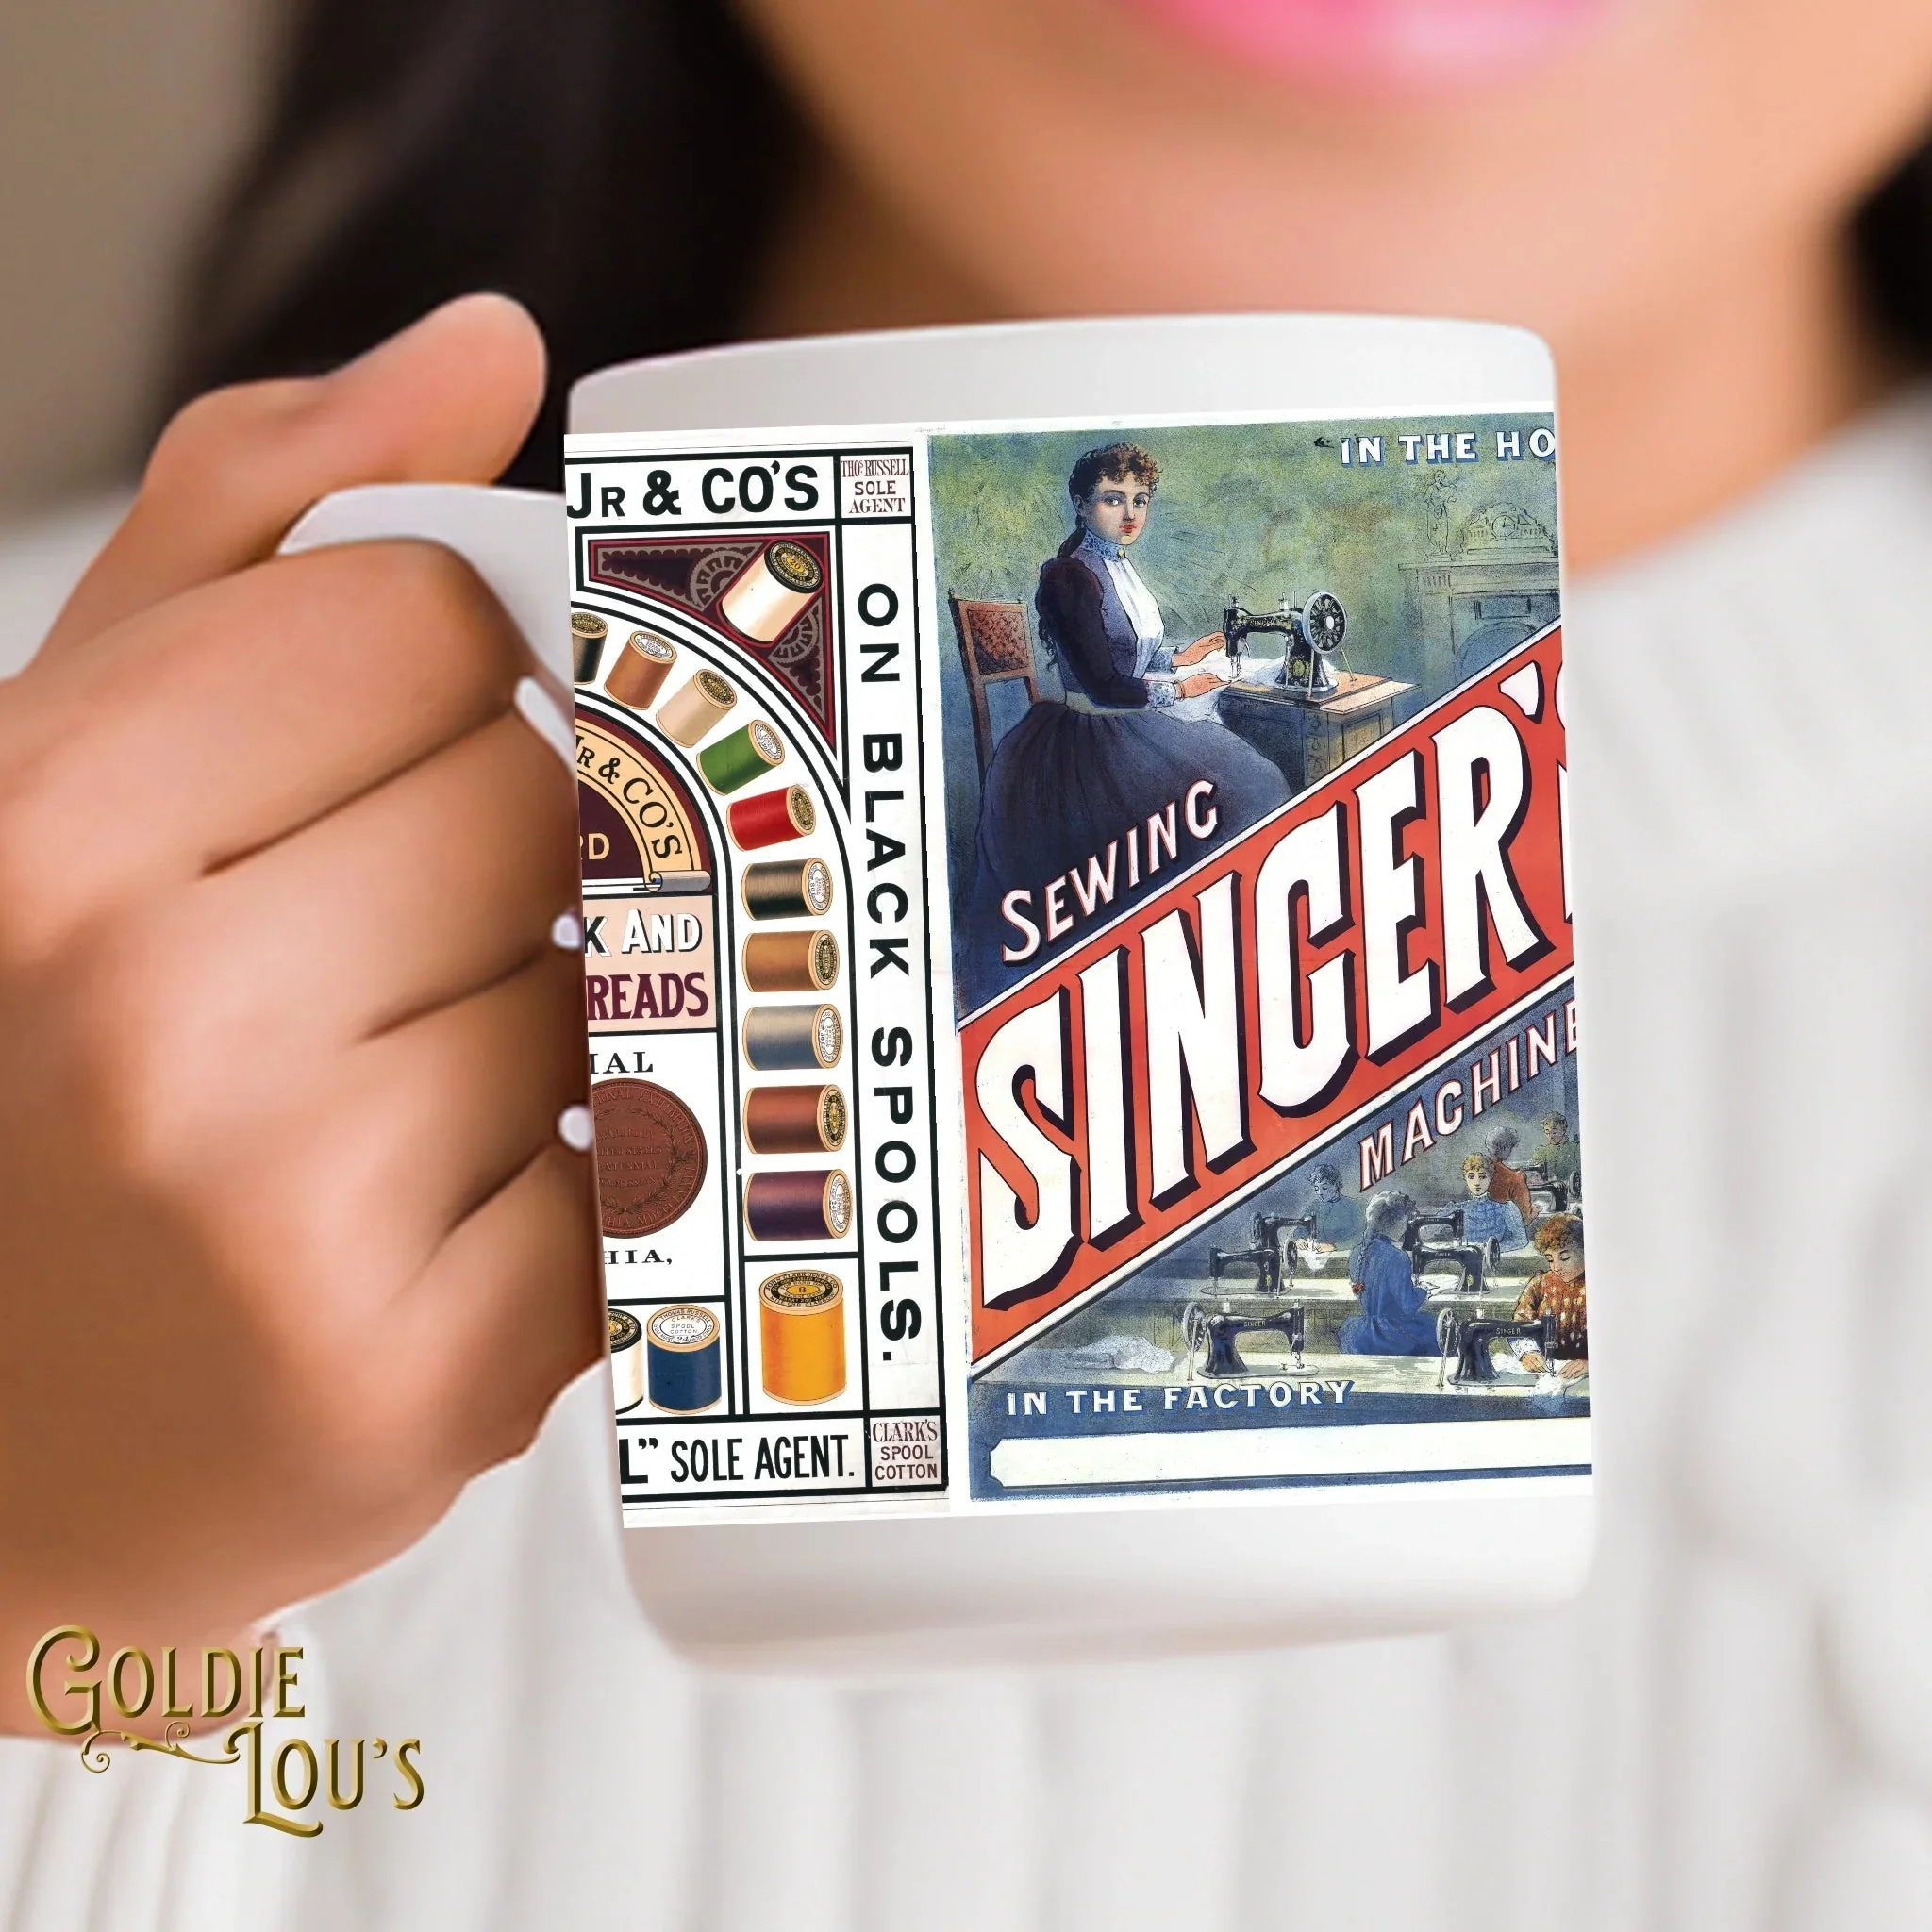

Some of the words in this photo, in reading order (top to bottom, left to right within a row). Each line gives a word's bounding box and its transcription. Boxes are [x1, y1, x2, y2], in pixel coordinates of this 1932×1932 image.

[864, 458, 909, 477] RUSSELL
[1341, 436, 1383, 467] IN
[1398, 432, 1478, 464] THE
[1495, 427, 1556, 460] HO
[642, 470, 681, 516] &
[701, 460, 819, 514] CO'S
[849, 498, 906, 513] AGENT
[854, 480, 896, 495] SOLE
[858, 583, 900, 682] ON
[598, 757, 620, 784] &
[623, 777, 682, 858] CO'S
[863, 733, 909, 979] BLACK
[1000, 779, 1219, 966] SEWING
[621, 908, 702, 954] AND
[975, 660, 1574, 1310] SINGER'
[871, 1025, 922, 1361] SPOOLS.
[1008, 1391, 1047, 1415] IN
[1066, 1389, 1143, 1414] THE
[1163, 1380, 1355, 1410] FACTORY
[872, 1419, 938, 1442] CLARK'S
[880, 1445, 934, 1461] SPOOL
[671, 1438, 744, 1483] SOLE
[754, 1434, 855, 1480] AGENT.
[874, 1464, 938, 1480] COTTON
